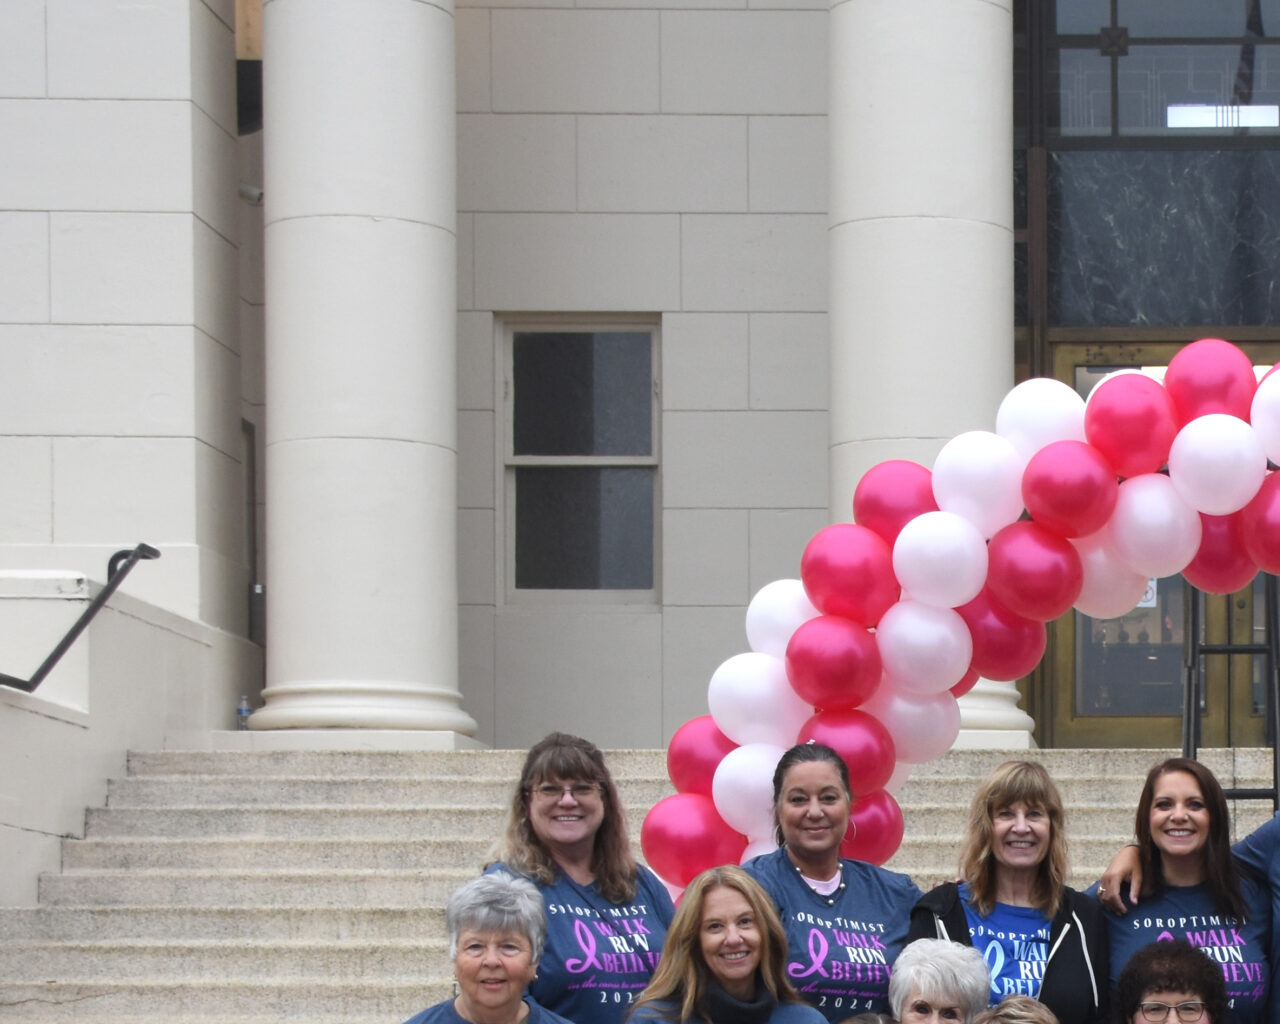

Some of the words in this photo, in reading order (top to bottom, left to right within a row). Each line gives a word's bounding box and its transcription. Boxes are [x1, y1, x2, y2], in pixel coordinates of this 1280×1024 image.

[792, 912, 885, 933] OROPTIMIST
[832, 929, 887, 950] WALK
[1186, 928, 1247, 948] WALK
[846, 946, 886, 965] RUN
[1019, 961, 1046, 979] RU
[1221, 963, 1264, 982] IEVE
[600, 991, 633, 1003] 202
[819, 996, 873, 1010] 2024
